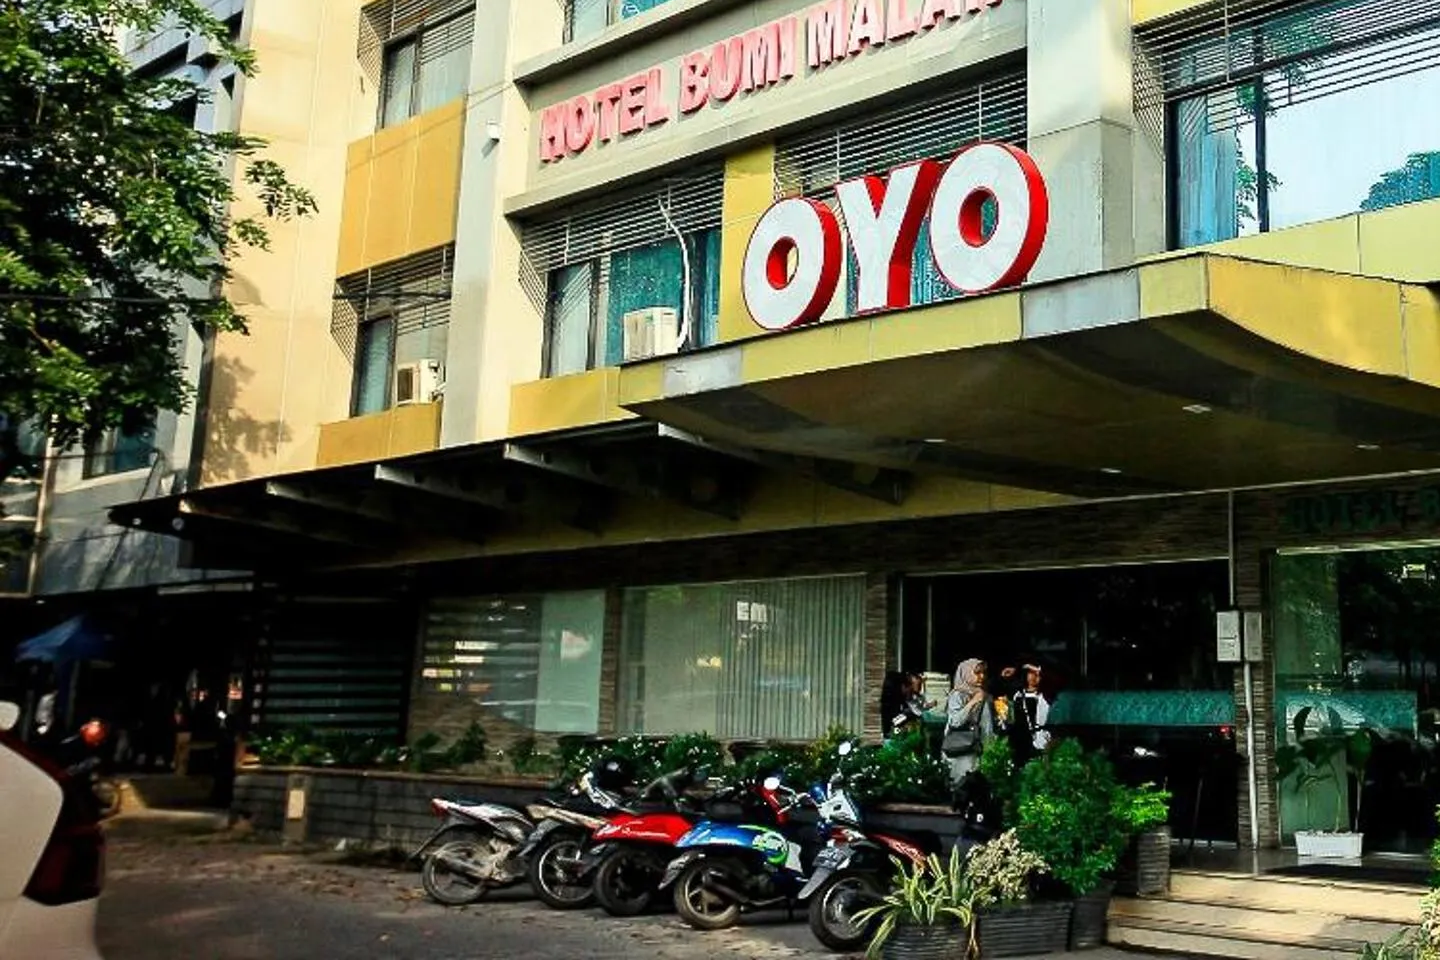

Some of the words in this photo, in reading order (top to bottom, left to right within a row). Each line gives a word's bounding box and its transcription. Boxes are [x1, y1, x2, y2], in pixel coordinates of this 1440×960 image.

[539, 68, 670, 163] HOTEL
[680, 16, 801, 114] BUMI
[742, 139, 1050, 331] OYO
[1286, 492, 1407, 534] HOTEL
